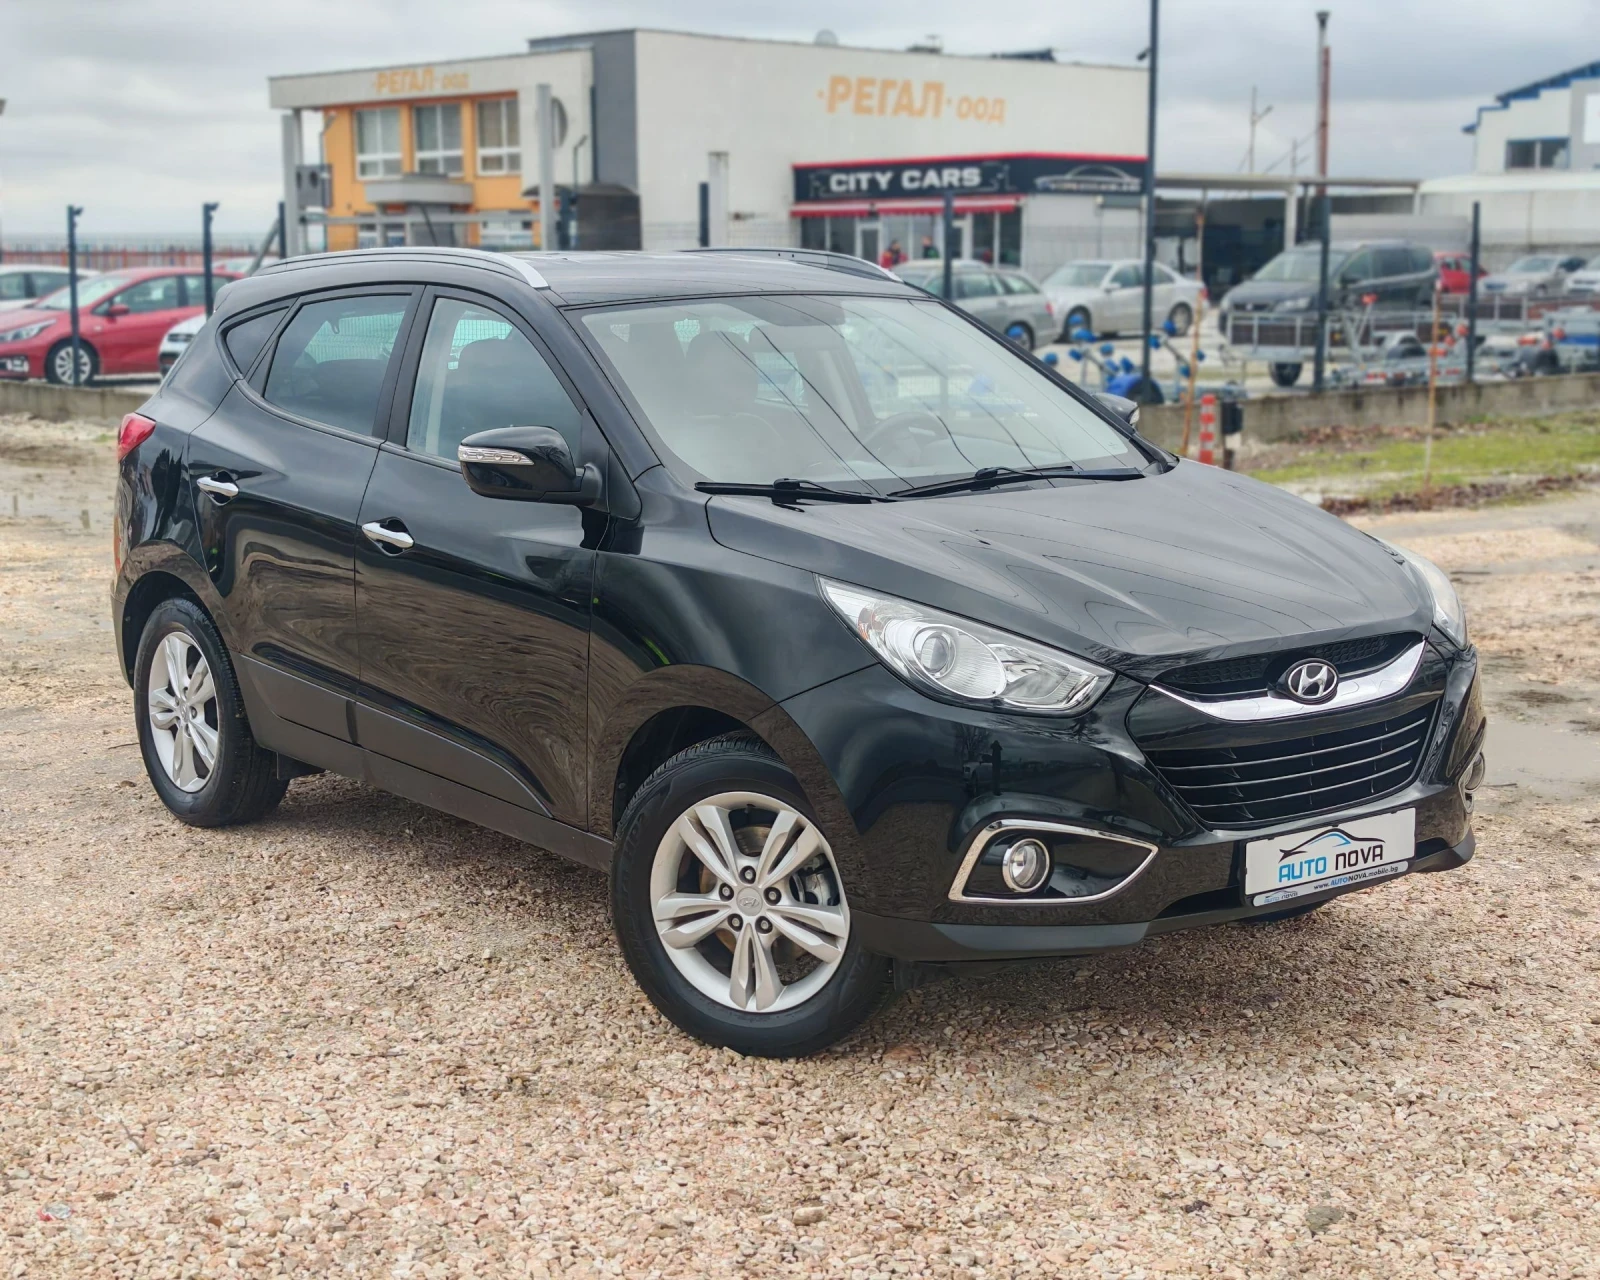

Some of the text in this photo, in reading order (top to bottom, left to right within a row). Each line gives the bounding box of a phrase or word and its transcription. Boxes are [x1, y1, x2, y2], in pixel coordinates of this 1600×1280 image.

[827, 75, 944, 118] РЕГАЛ
[829, 168, 982, 192] CITY CARS
[1278, 844, 1383, 883] AUTO NOVA
